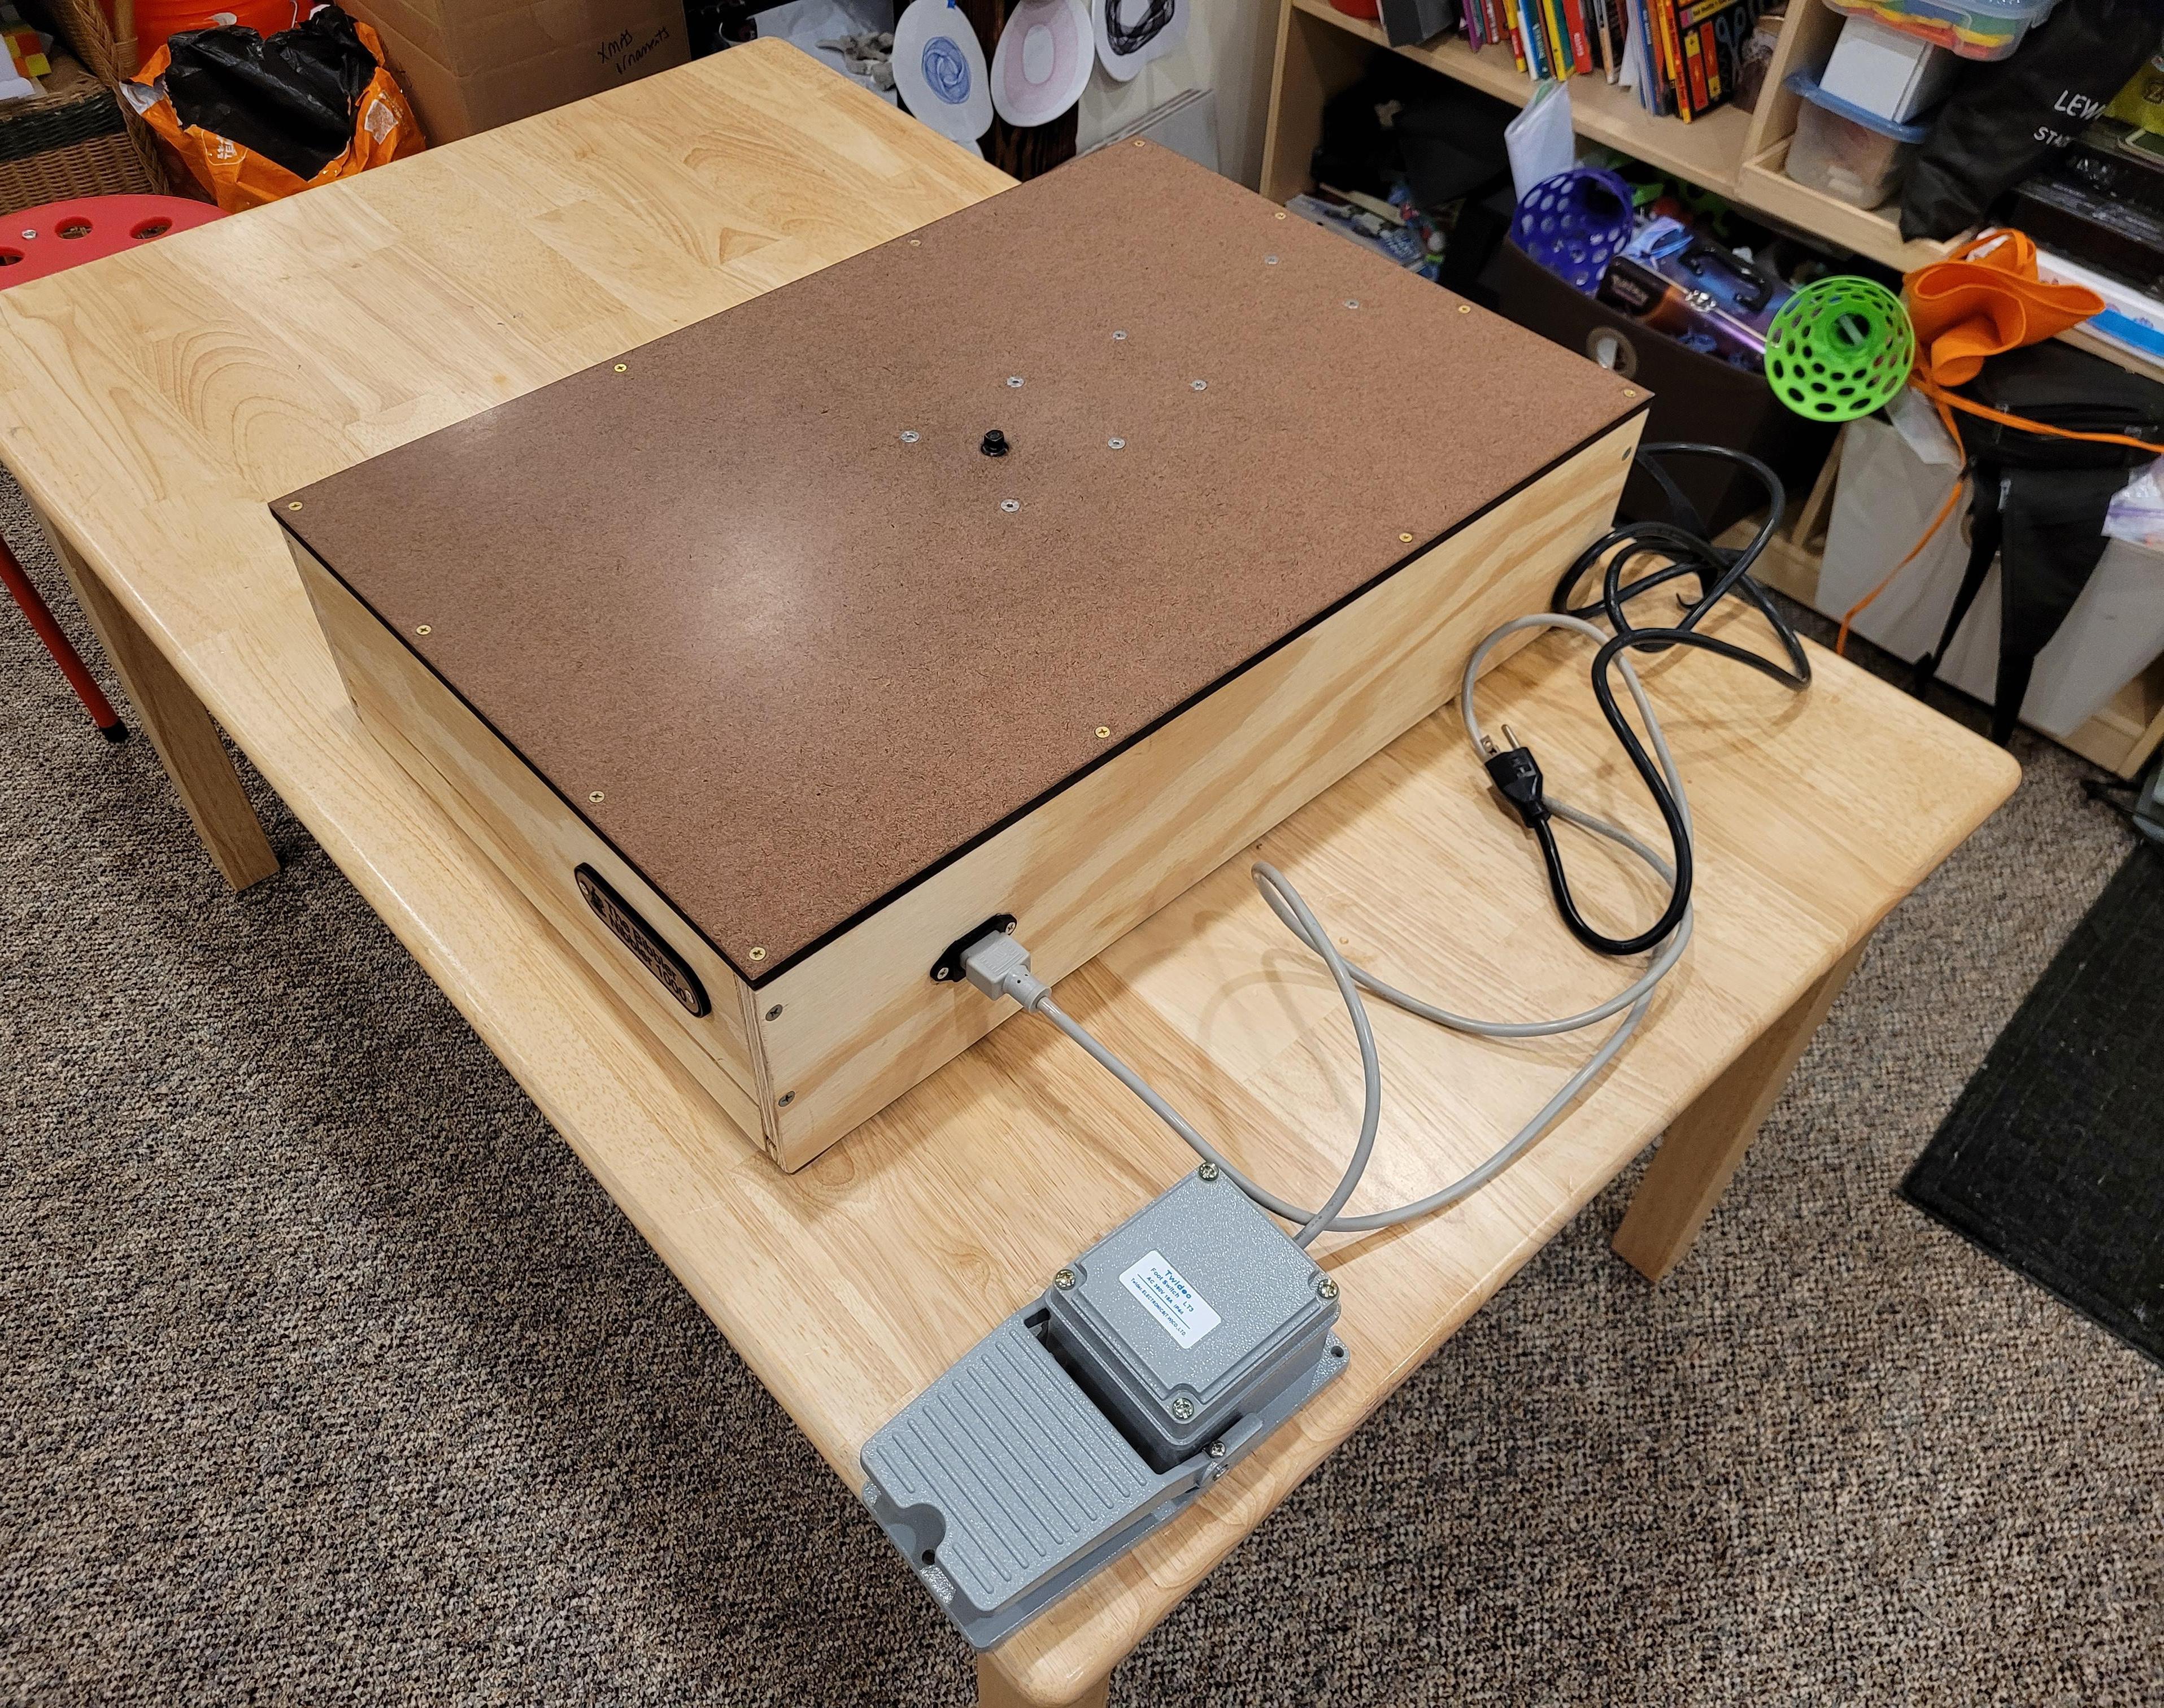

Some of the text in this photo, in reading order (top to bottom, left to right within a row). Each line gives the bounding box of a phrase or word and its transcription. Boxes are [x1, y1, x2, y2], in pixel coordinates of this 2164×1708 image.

[604, 899, 677, 981] The Bibbler
[608, 914, 687, 1003] Nibbler 1000
[1151, 1267, 1194, 1312] Foot Switch LT3
[1153, 1283, 1165, 1295] 380V
